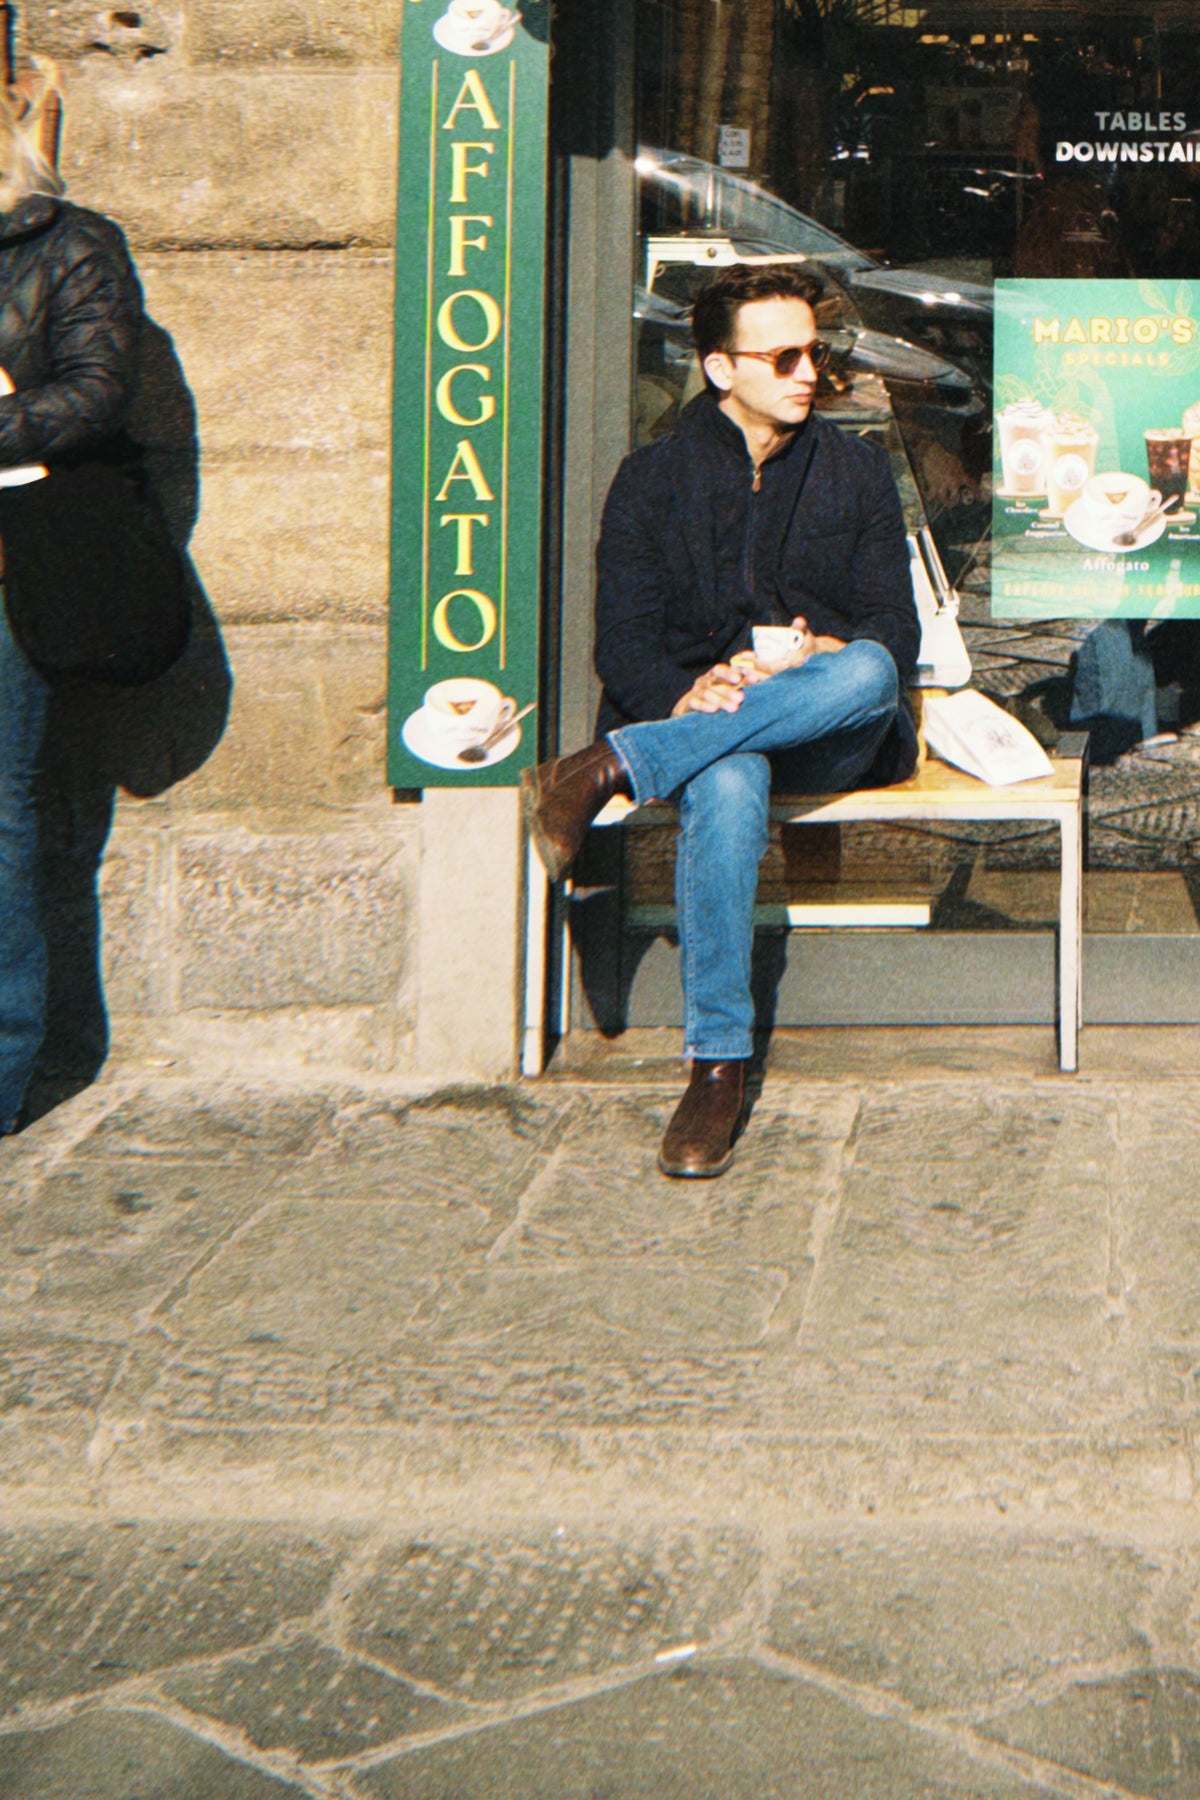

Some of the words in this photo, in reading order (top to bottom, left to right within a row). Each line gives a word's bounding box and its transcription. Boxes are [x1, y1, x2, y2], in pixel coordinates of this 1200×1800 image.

[1094, 111, 1187, 131] TABLES
[1032, 317, 1195, 344] MARIO'S
[432, 68, 501, 653] AFFOGATO
[1063, 351, 1170, 367] SPECIALS
[1082, 554, 1150, 576] Affogato
